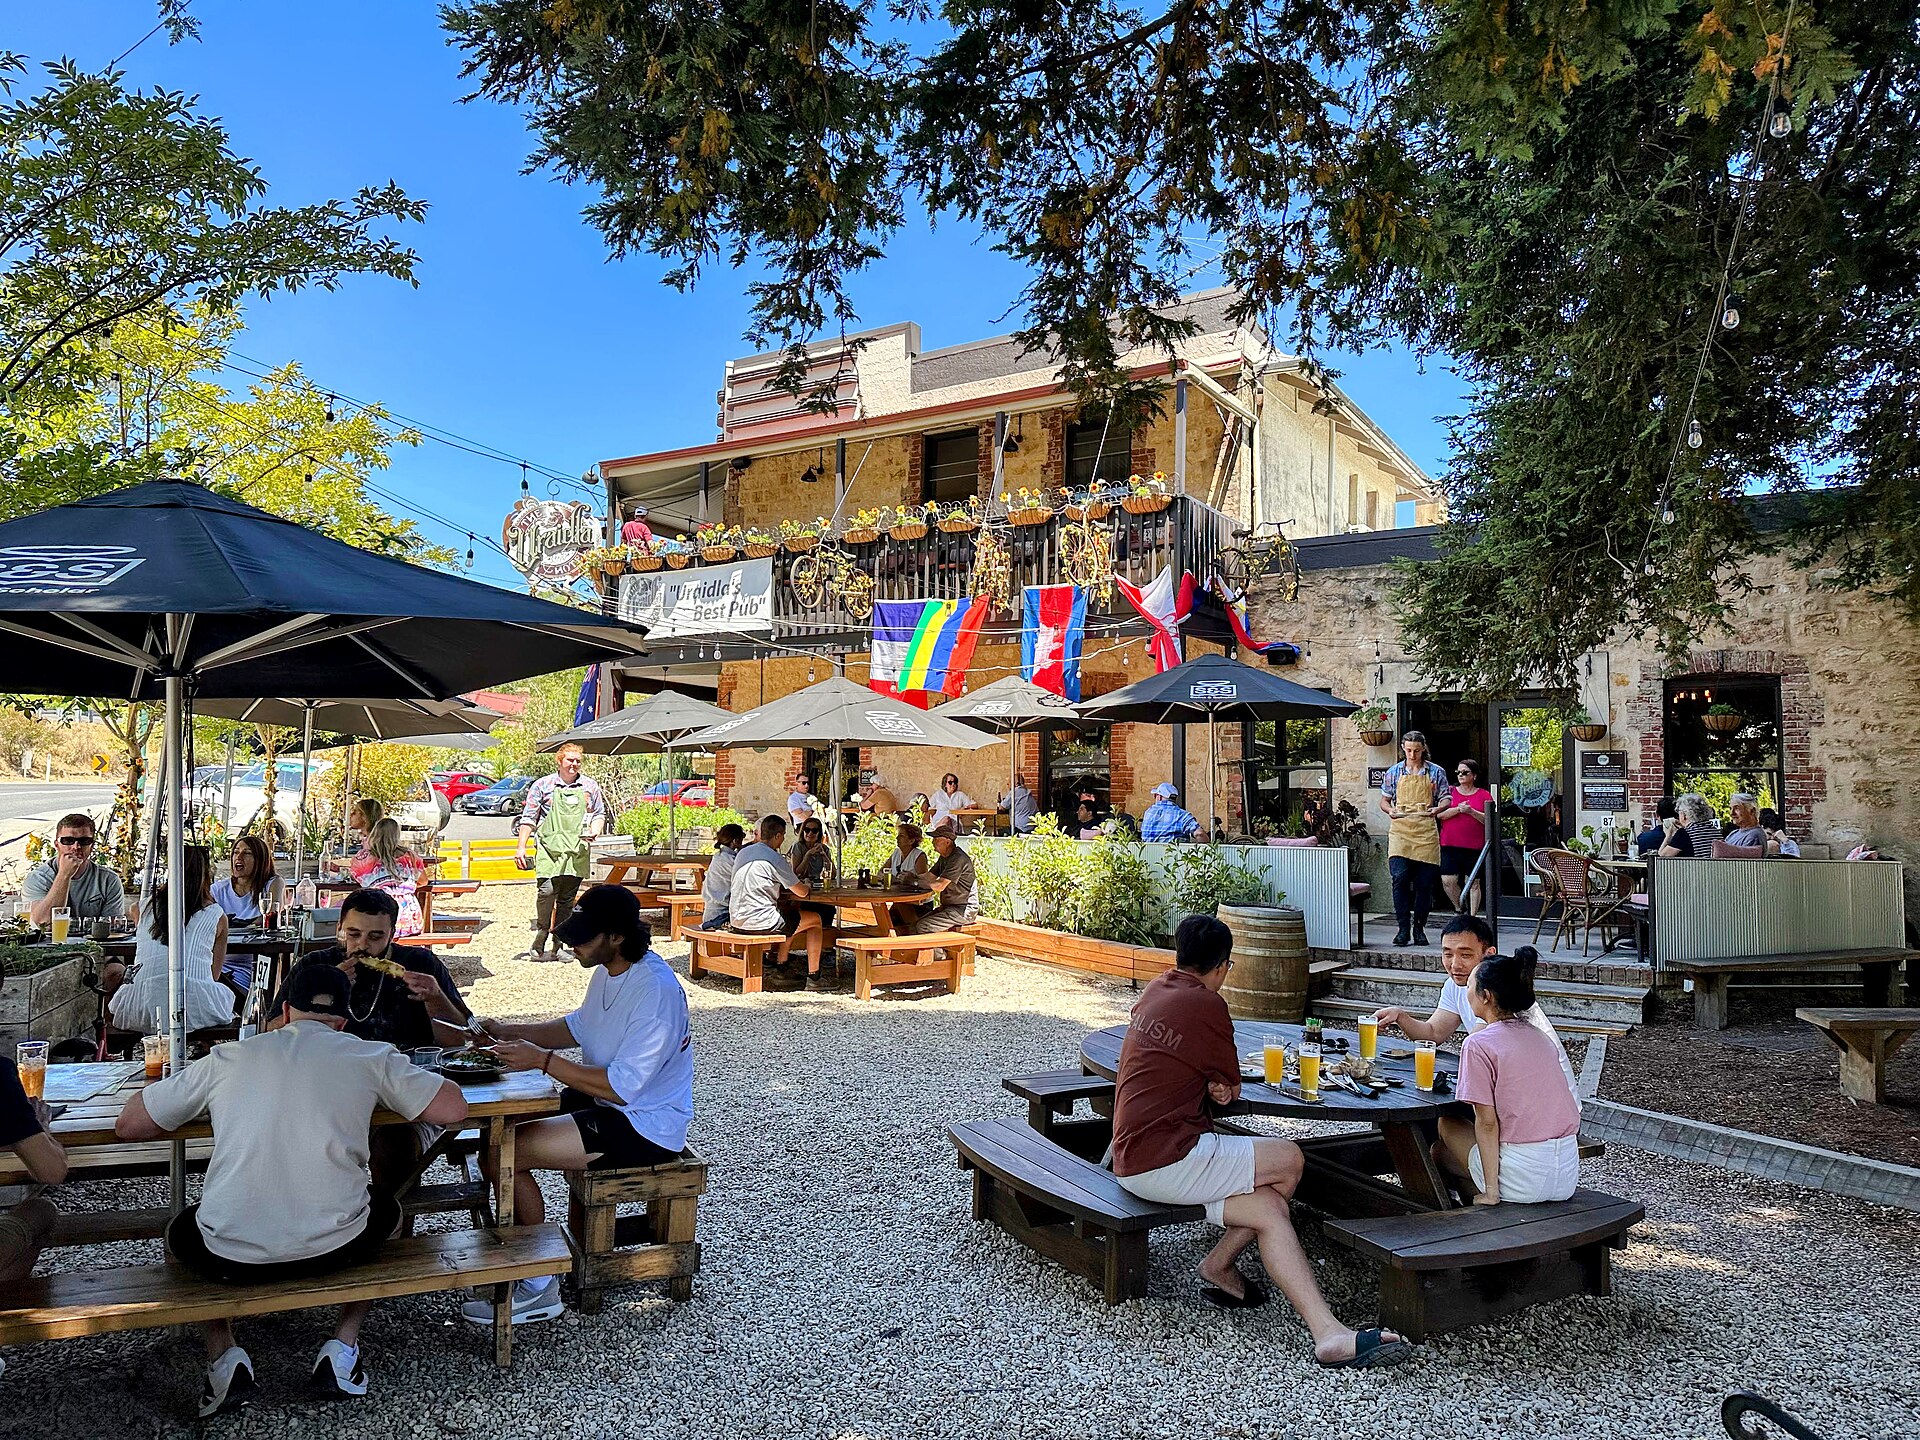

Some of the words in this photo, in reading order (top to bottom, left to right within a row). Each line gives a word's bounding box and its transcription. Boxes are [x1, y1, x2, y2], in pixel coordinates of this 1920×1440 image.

[520, 509, 542, 528] THE
[508, 504, 595, 569] Uraidla
[0, 563, 116, 579] &S
[693, 604, 726, 622] Best
[728, 596, 766, 618] Pub"
[1603, 817, 1614, 826] 87
[258, 960, 269, 982] 97
